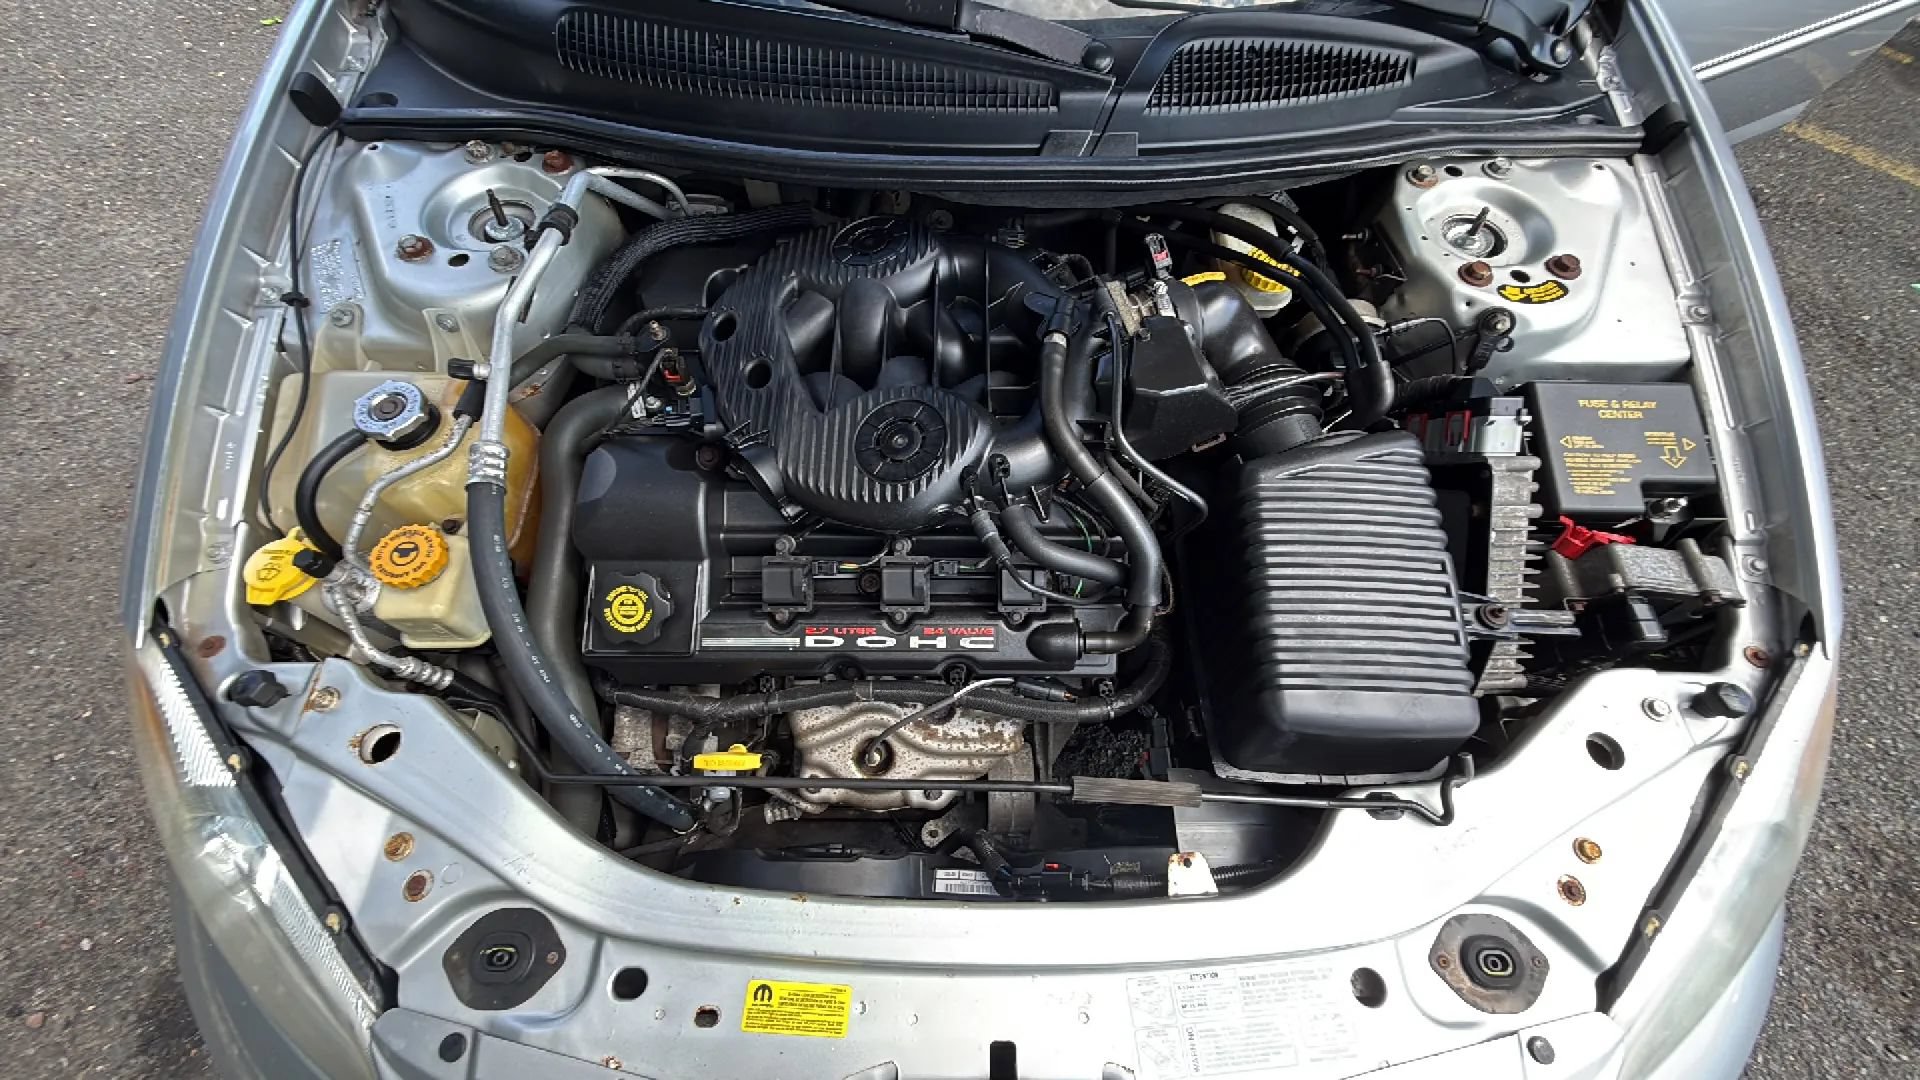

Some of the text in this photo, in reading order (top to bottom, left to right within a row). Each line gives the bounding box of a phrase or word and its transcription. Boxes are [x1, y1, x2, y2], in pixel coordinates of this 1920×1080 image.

[1578, 399, 1609, 408] FUSE
[1622, 400, 1657, 409] RELAY
[1598, 409, 1644, 419] CENTER
[805, 627, 877, 635] 2.7 LITER
[923, 627, 995, 636] 24 VALVE
[805, 635, 994, 648] DOHC
